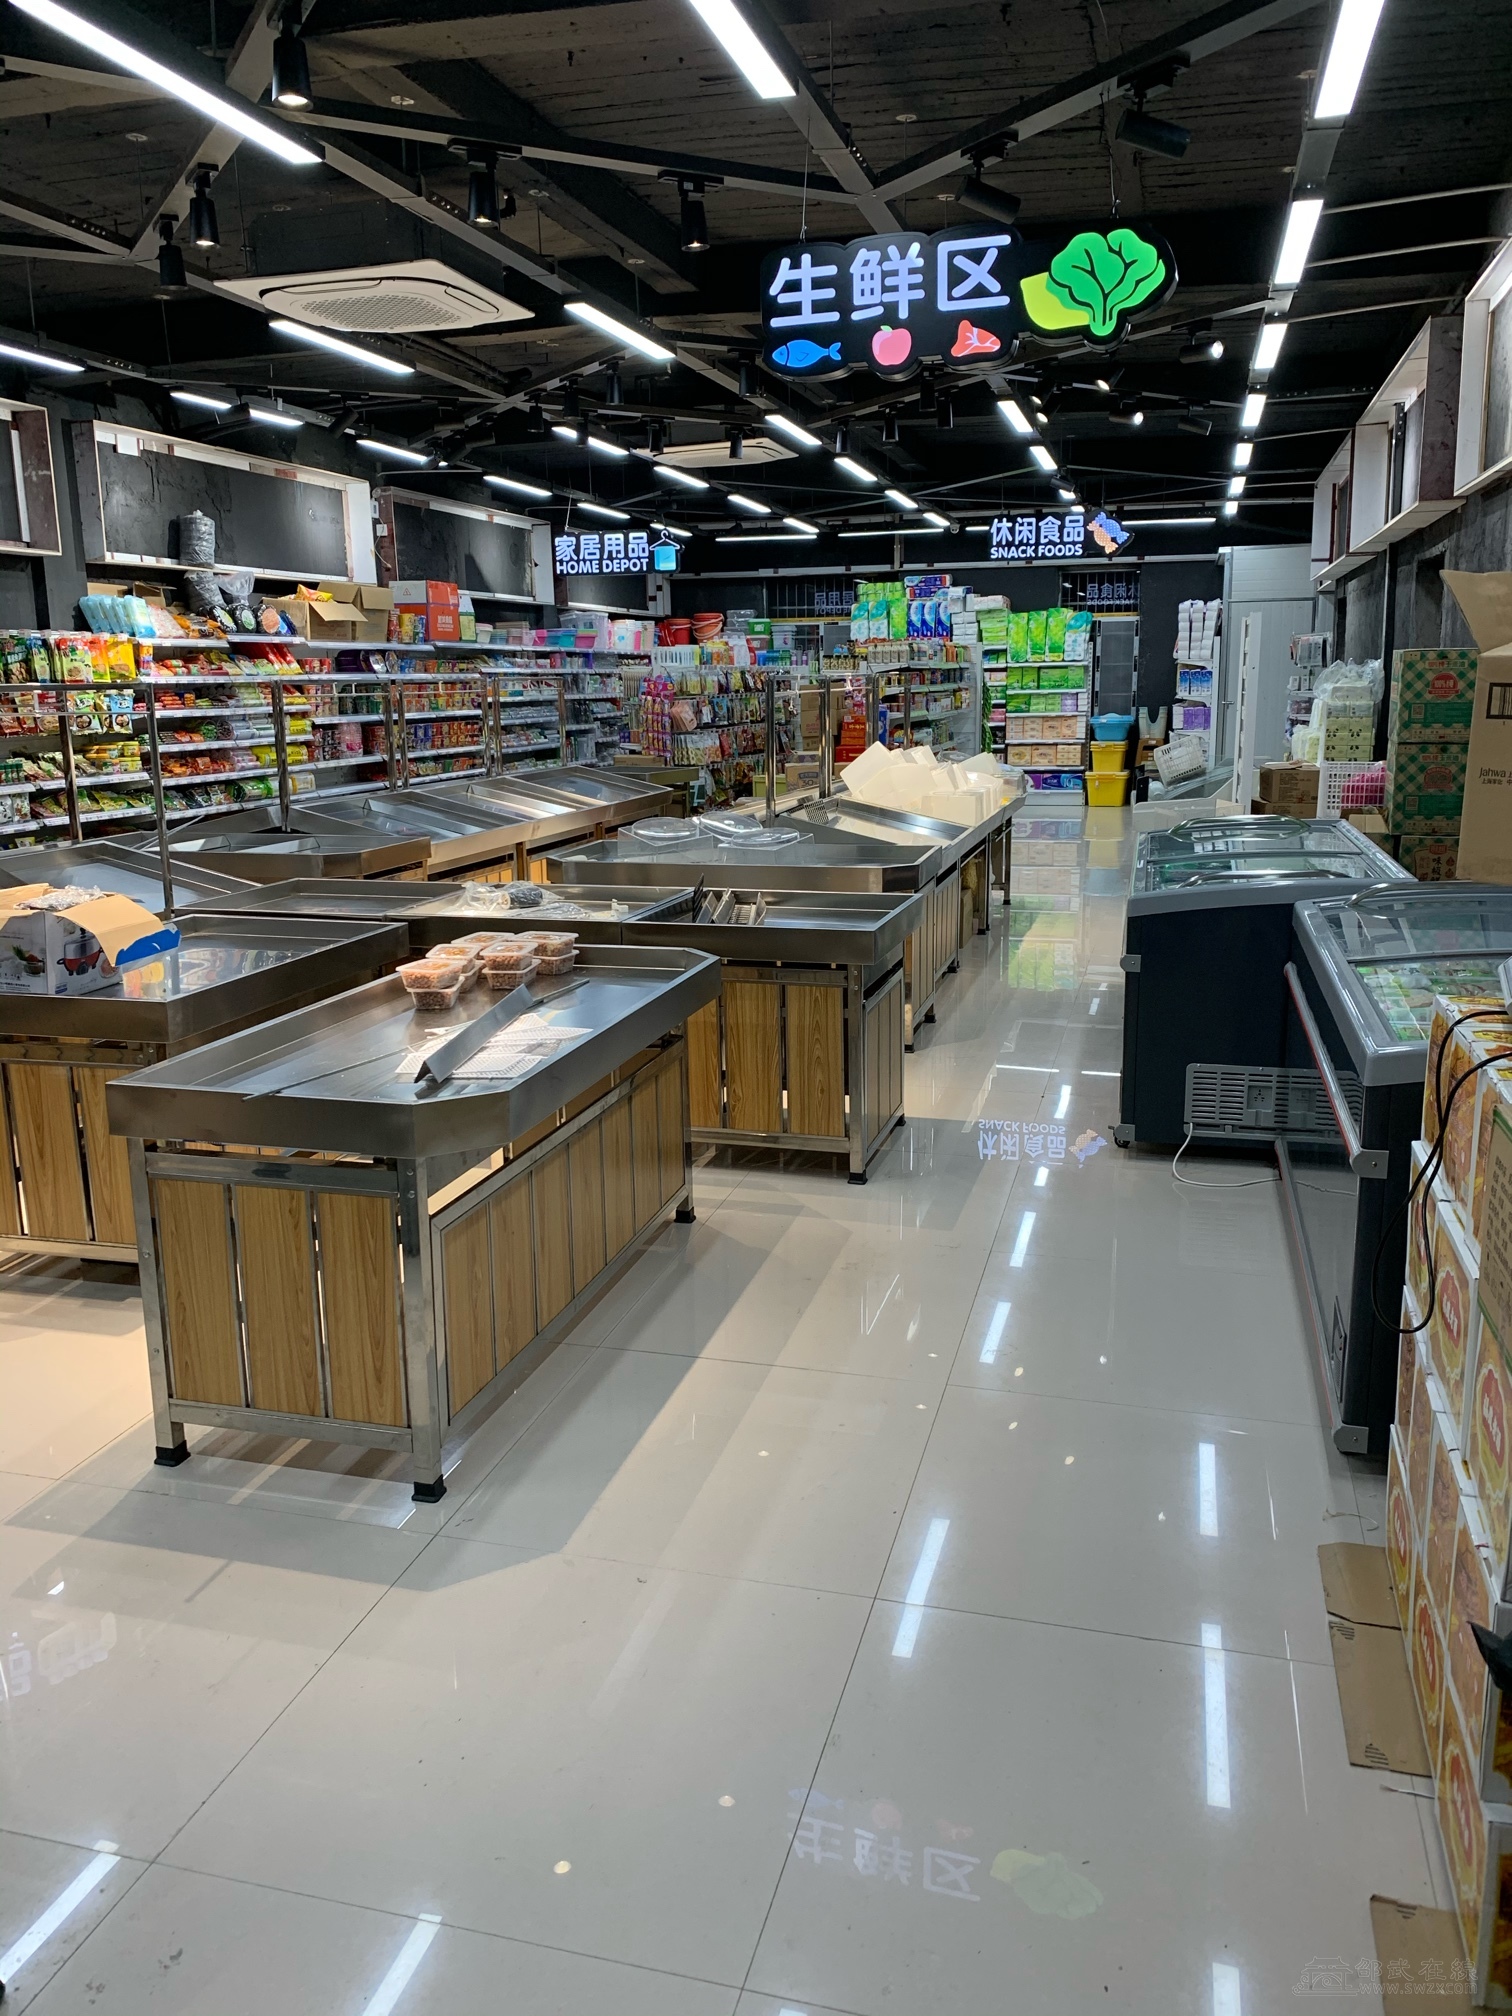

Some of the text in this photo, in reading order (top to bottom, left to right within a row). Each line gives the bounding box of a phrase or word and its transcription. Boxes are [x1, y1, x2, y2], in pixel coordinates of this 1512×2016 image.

[770, 234, 1012, 328] 生鲜区
[990, 515, 1085, 546] 休闲食品
[555, 532, 650, 561] 家居用品
[991, 543, 1083, 559] SNACK FOODS
[556, 558, 649, 575] HOME DEPOT
[1479, 767, 1507, 779] Jahwa
